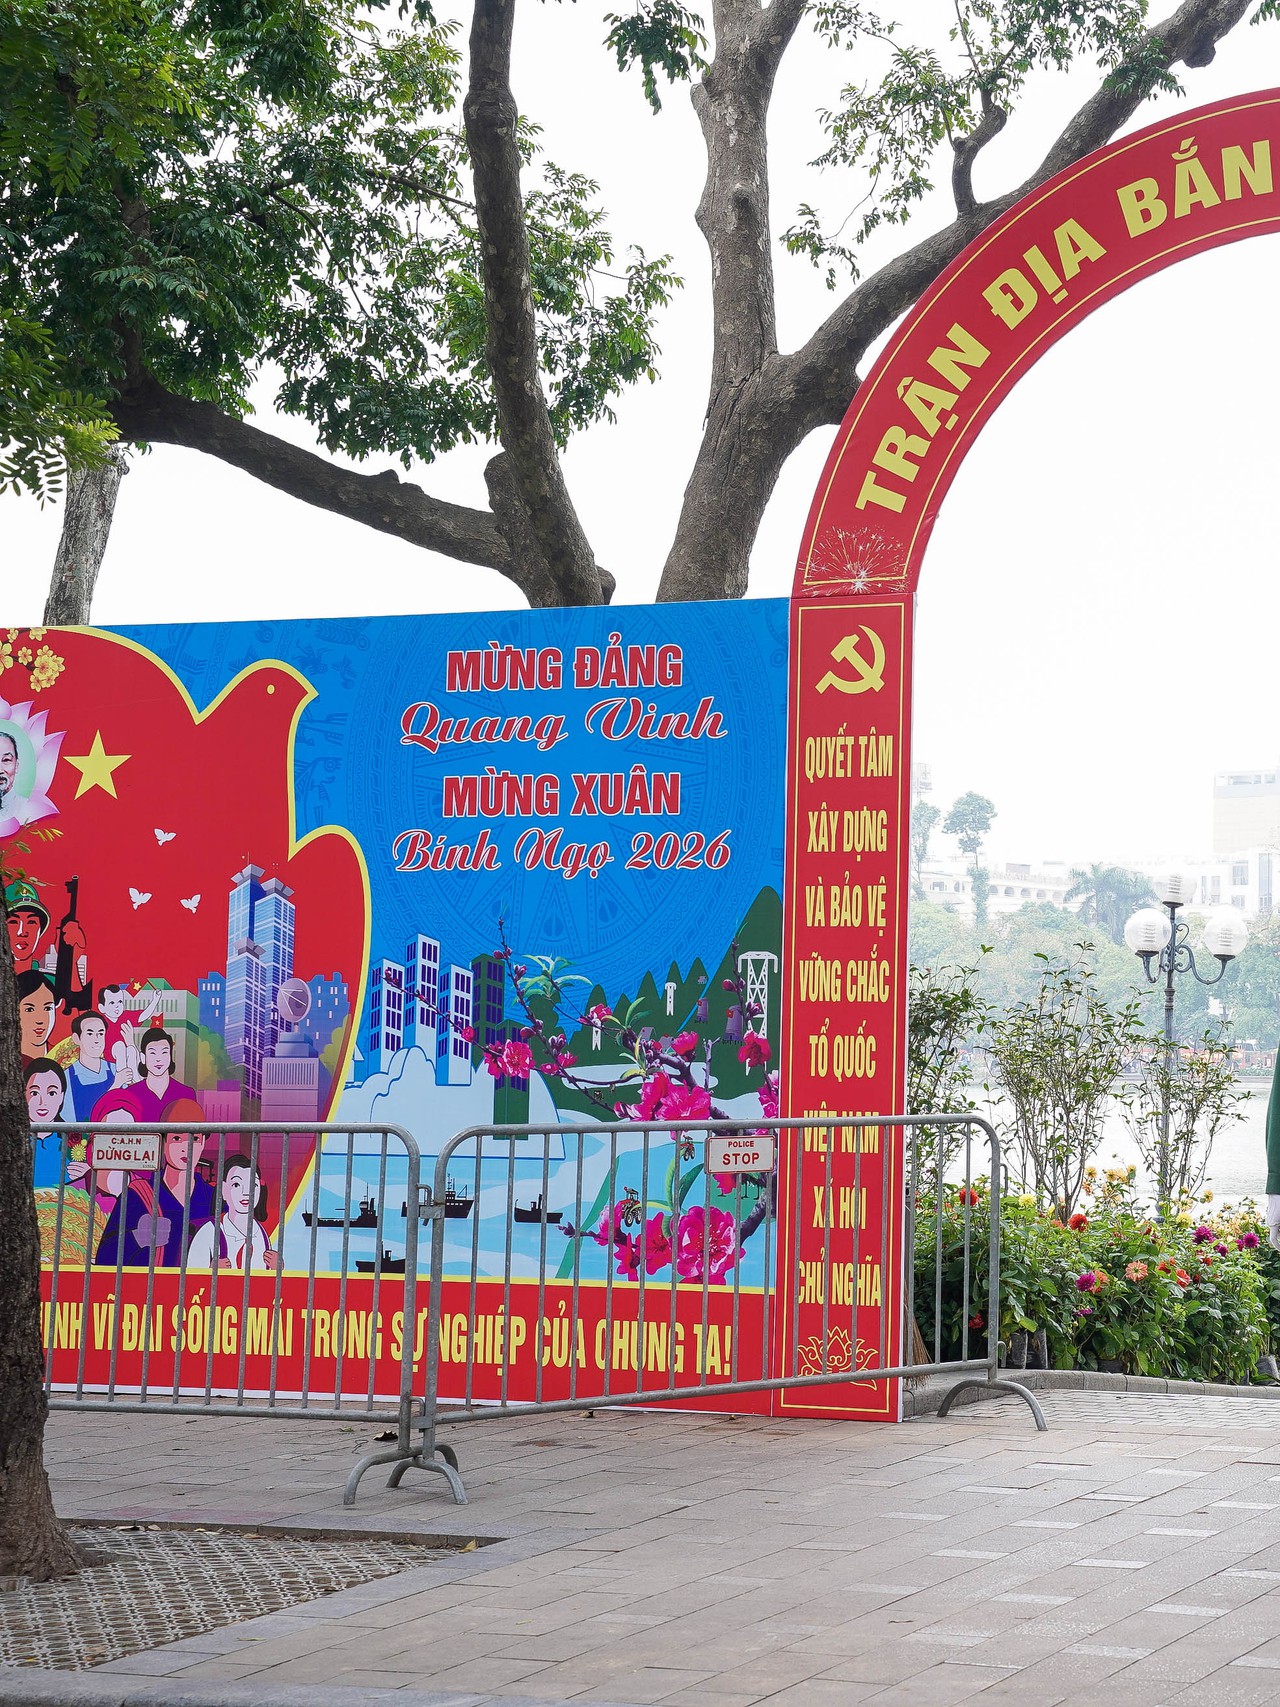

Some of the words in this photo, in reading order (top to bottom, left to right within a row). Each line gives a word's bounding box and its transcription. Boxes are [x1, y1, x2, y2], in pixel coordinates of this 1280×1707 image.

[856, 323, 992, 512] TRẬN
[982, 219, 1104, 329] ĐỊA
[1117, 138, 1272, 236] BẮN
[446, 641, 563, 692] MỪNG
[573, 632, 683, 689] ĐẢNG
[400, 701, 569, 755] Quang
[585, 697, 728, 741] Vinh
[805, 723, 854, 781] QUYẾT
[859, 727, 892, 777] TÂM
[443, 766, 560, 818] MỪNG
[570, 763, 681, 816] XUÂN
[392, 828, 502, 872] Bính
[514, 827, 615, 880] Ngọ
[625, 829, 732, 870] 2026
[808, 803, 838, 852] XÂY
[844, 807, 887, 861] DỰNG
[806, 876, 825, 926] VÀ
[830, 872, 862, 927] BẢO
[868, 878, 886, 936] VỆ
[800, 950, 841, 1002] VỮNG
[847, 944, 889, 1002] CHẮC
[810, 1017, 828, 1077] TỔ
[834, 1020, 876, 1080] QUỐC
[96, 1145, 132, 1161] DỪNG
[133, 1150, 155, 1164] LẠI
[722, 1152, 760, 1166] STOP
[728, 1140, 754, 1148] POLICE
[804, 1102, 837, 1162] VIỆT
[842, 1111, 878, 1153] NAM
[832, 1256, 881, 1306] NGHĨA
[40, 1302, 83, 1349] INH
[171, 1288, 237, 1354] SỐNG
[302, 1309, 382, 1359] TRONG
[439, 1305, 526, 1375] NGHIỆP
[535, 1301, 585, 1367] CỦA
[694, 1324, 731, 1375] TA!
